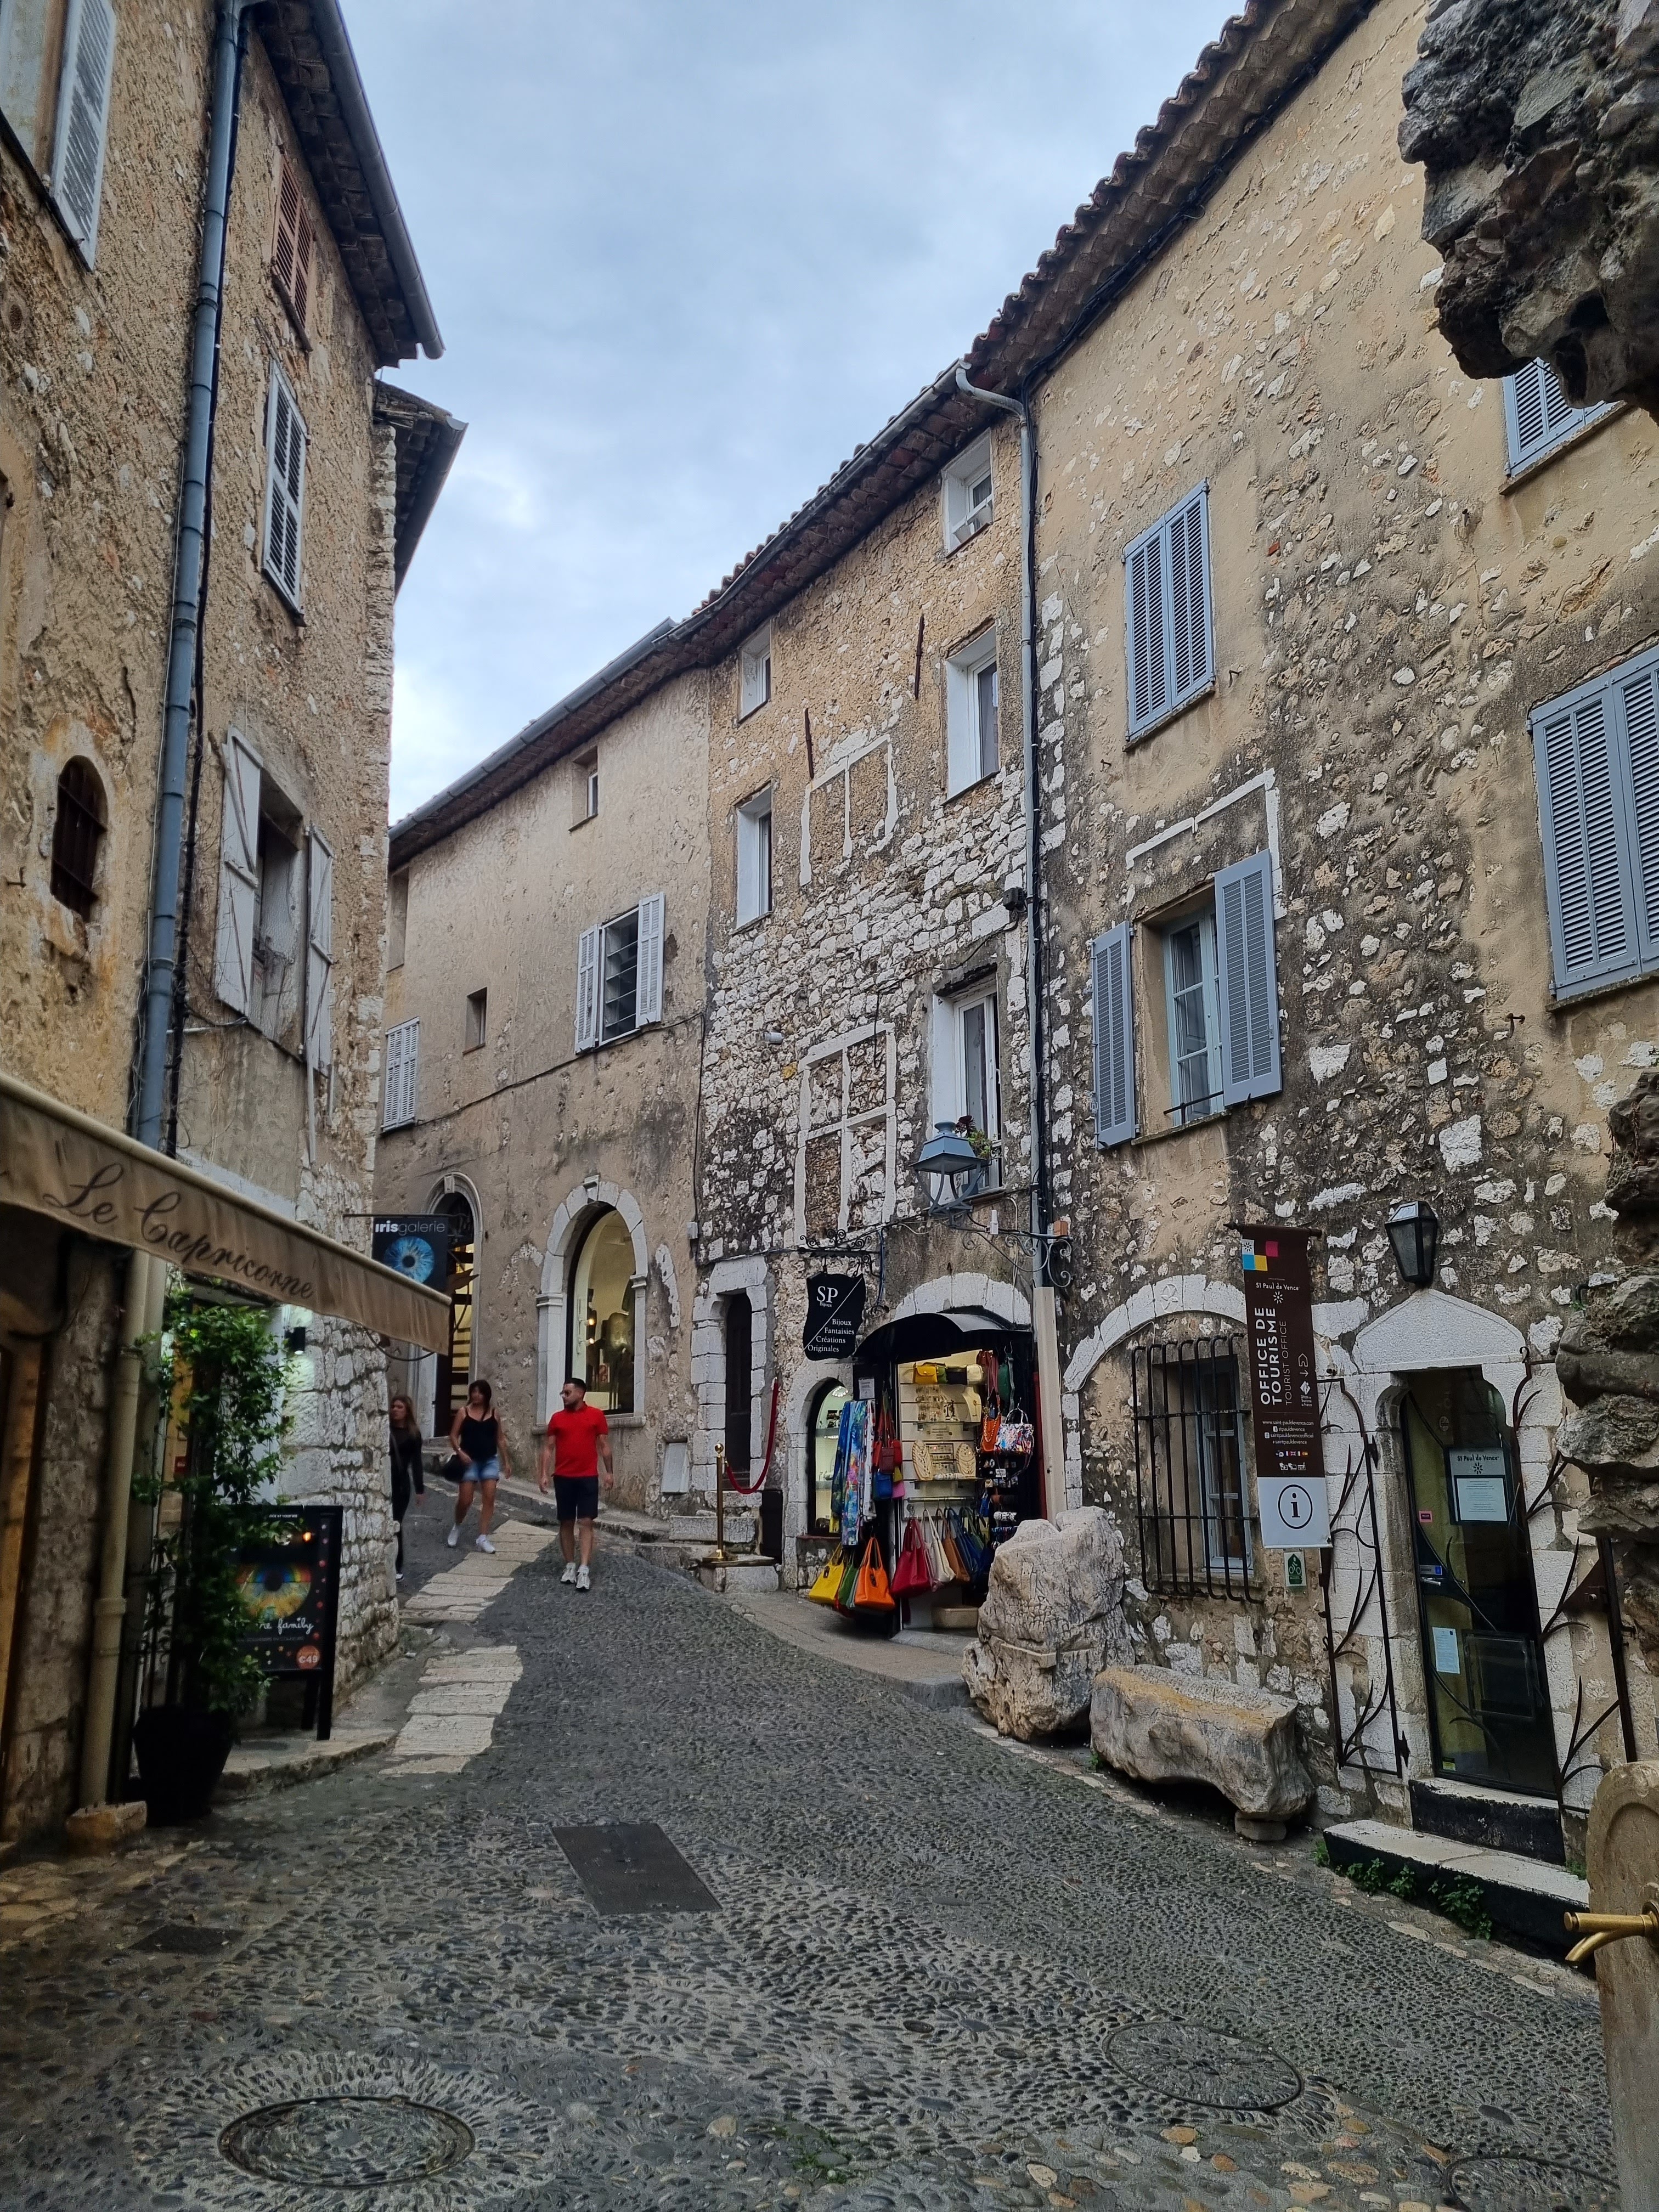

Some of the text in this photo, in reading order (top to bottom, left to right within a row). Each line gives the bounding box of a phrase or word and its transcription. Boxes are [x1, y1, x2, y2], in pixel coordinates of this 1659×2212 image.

[42, 1163, 315, 1299] Le Capricorne
[816, 1285, 838, 1304] SP
[832, 1318, 851, 1327] Bijoux
[808, 1345, 839, 1353] Originales
[1254, 1307, 1271, 1405] OFFICE DE
[1266, 1308, 1282, 1406] TOURISME
[1279, 1321, 1293, 1406] TOURIST OFFICE
[276, 1617, 314, 1636] family
